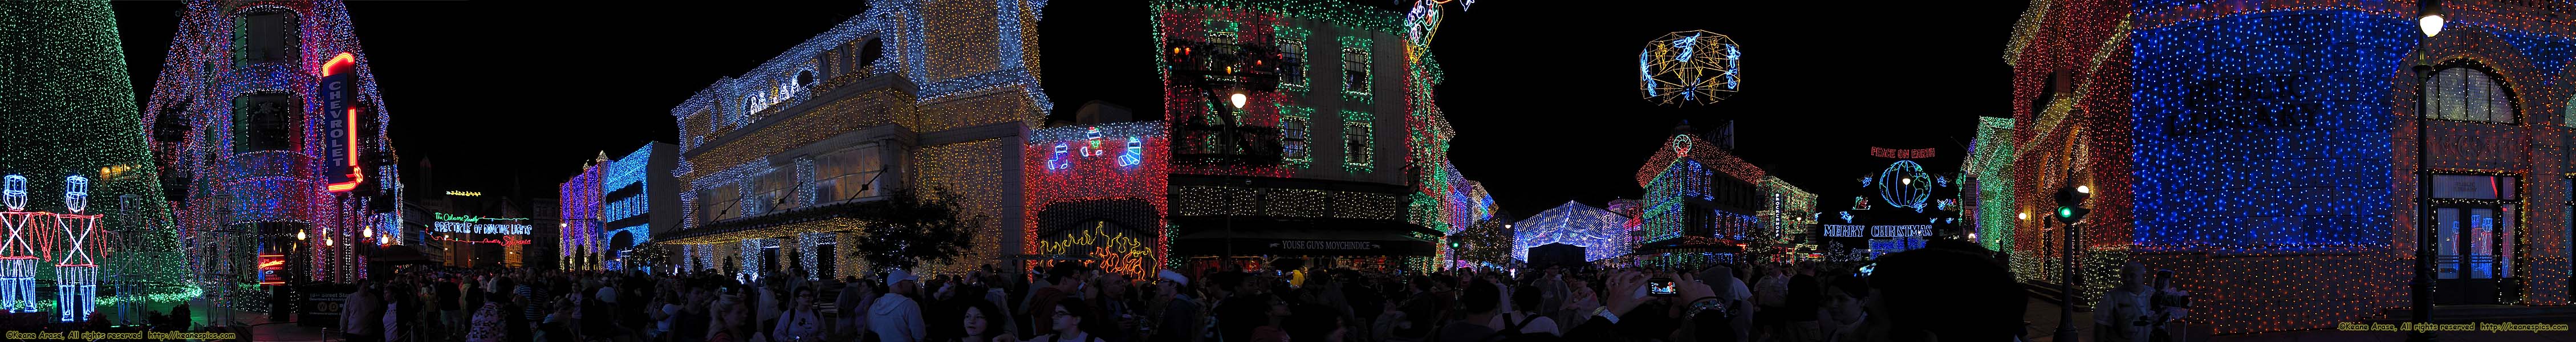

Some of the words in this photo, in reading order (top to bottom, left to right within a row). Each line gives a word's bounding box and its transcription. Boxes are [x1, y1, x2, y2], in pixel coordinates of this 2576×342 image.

[2187, 75, 2309, 106] PUBLIC
[328, 81, 343, 166] CHEVROLET
[2167, 103, 2322, 137] LIBRARY
[1871, 146, 1896, 158] PEACE
[1898, 149, 1909, 158] ON
[1911, 148, 1935, 158] EARTH
[474, 224, 483, 234] OF
[511, 223, 533, 235] LIGHTS
[1824, 225, 1865, 237] MERRY
[1871, 225, 1933, 237] CHRISTMAS
[501, 235, 531, 247] Sylvania
[1282, 241, 1305, 249] YOUSE
